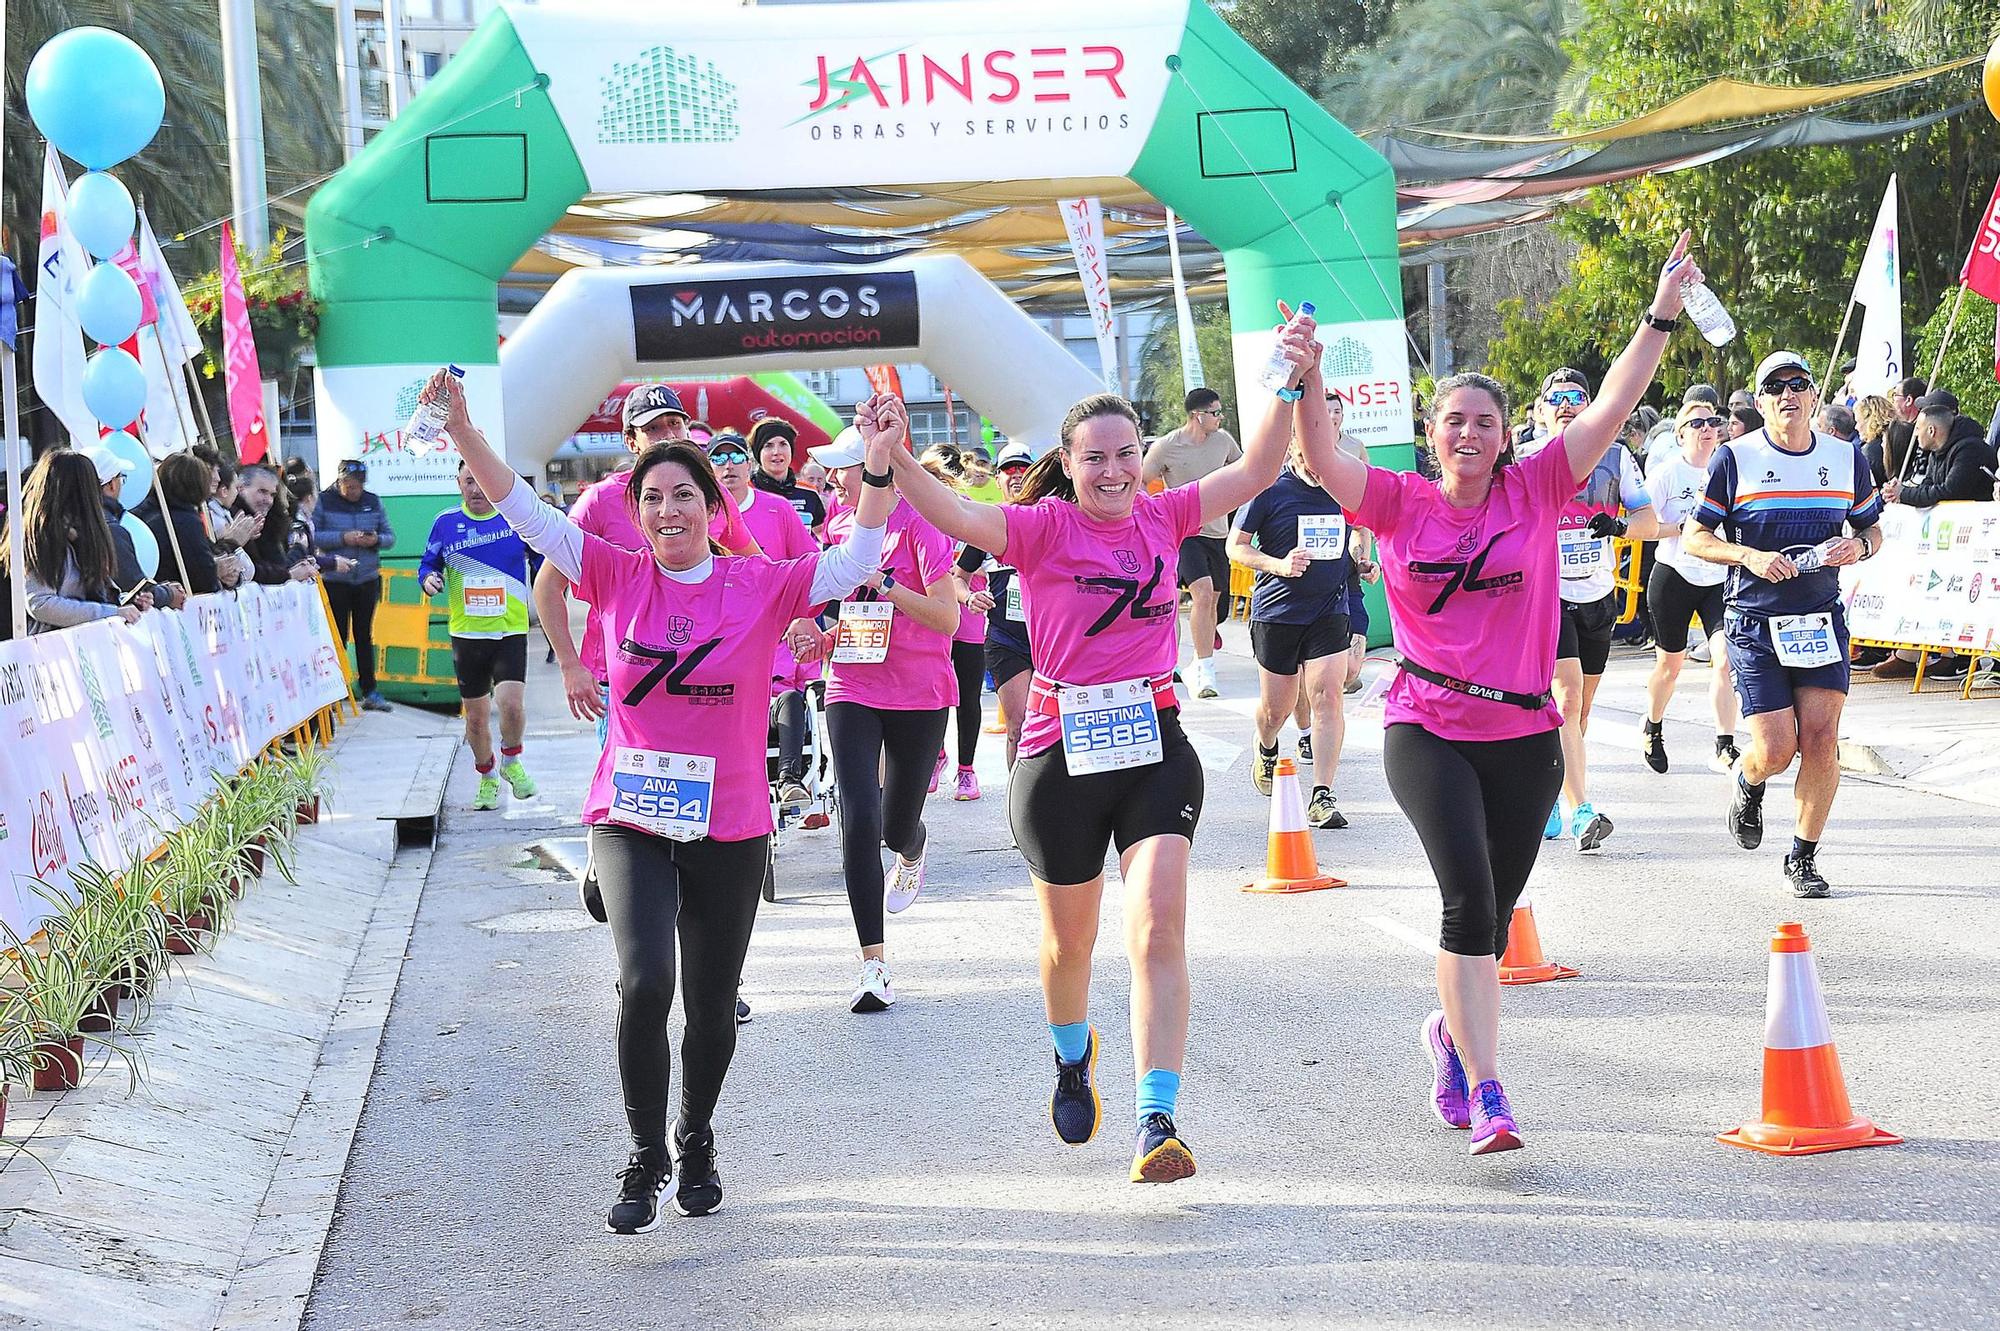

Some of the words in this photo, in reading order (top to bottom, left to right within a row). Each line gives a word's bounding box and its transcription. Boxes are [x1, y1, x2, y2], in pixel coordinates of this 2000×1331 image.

[809, 45, 1127, 109] JAINSER
[810, 122, 906, 141] OBRAS
[931, 121, 945, 136] Y
[966, 112, 1130, 135] SERVICIOS
[670, 286, 882, 328] MARCOS
[741, 326, 882, 349] automoción
[1305, 537, 1338, 548] 2179
[1562, 551, 1601, 566] 1669
[1853, 593, 1885, 609] EVENTOS
[839, 631, 887, 648] 5369
[1781, 641, 1829, 655] 1449
[1074, 705, 1146, 729] CRISTINA
[1068, 719, 1154, 753] 5585
[641, 777, 680, 795] ANA
[618, 790, 704, 822] 5594
